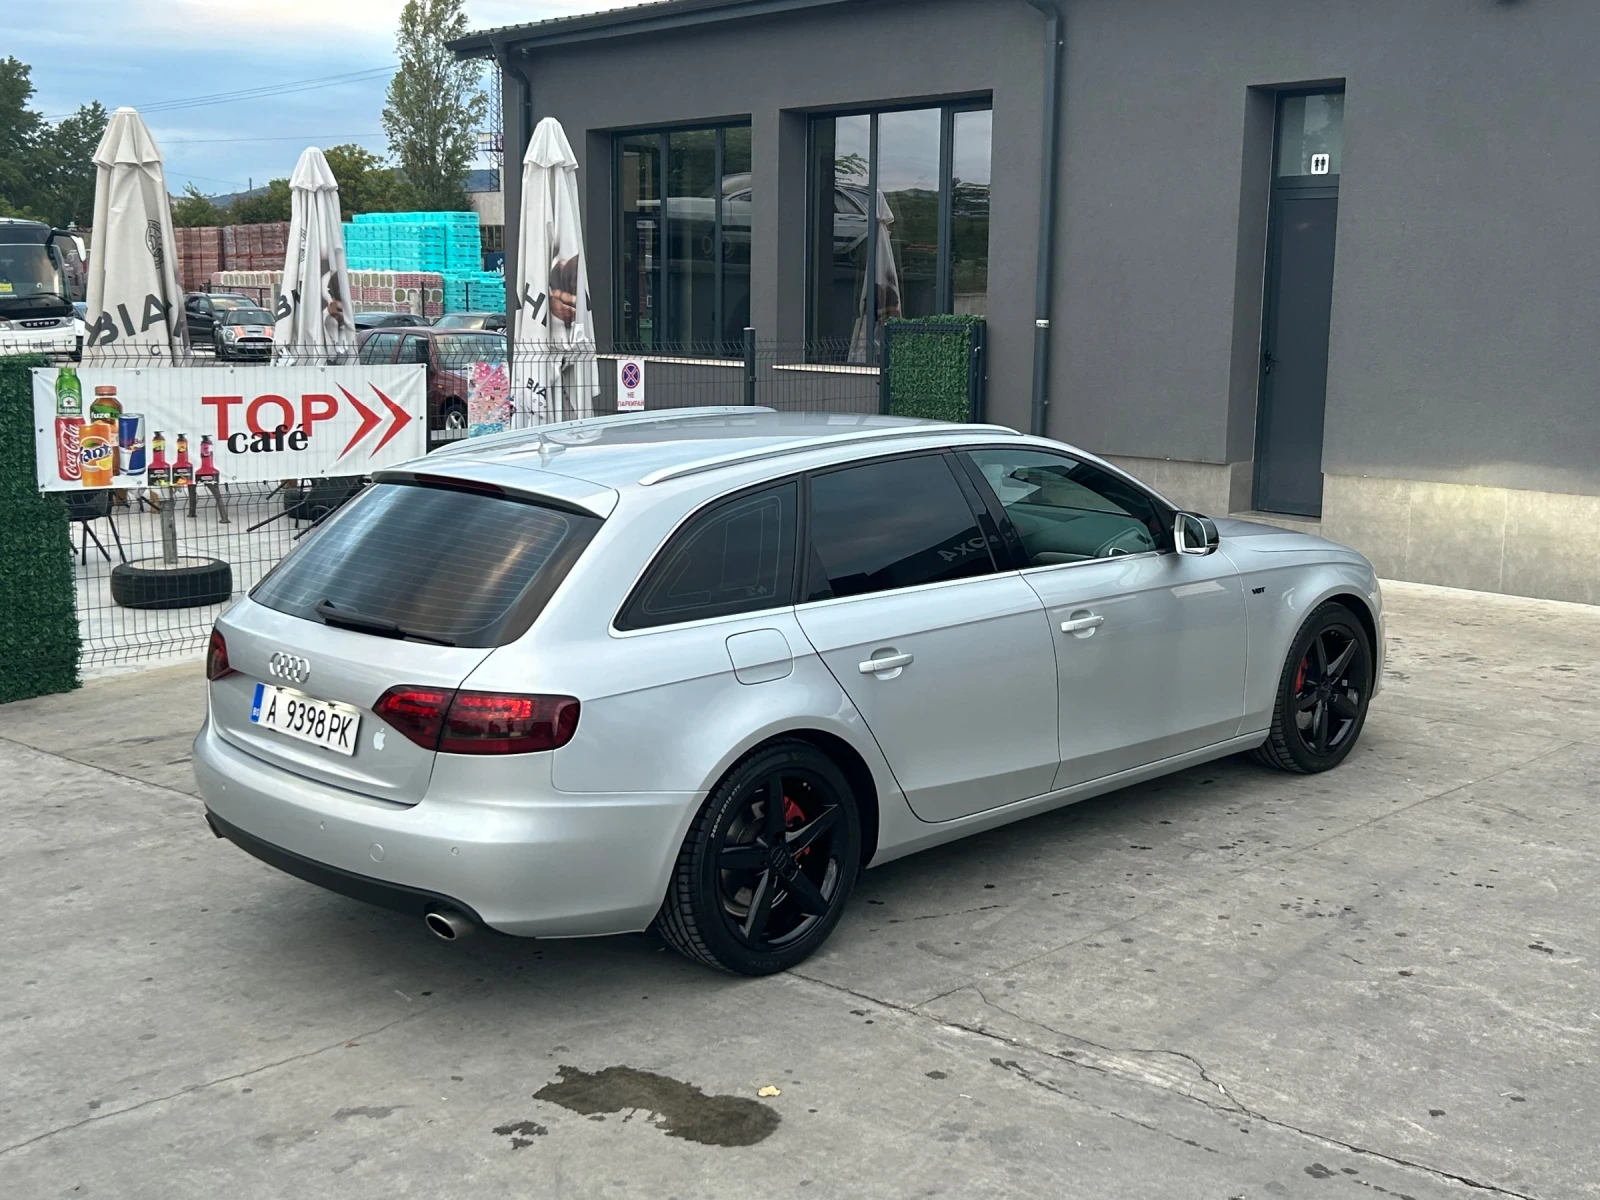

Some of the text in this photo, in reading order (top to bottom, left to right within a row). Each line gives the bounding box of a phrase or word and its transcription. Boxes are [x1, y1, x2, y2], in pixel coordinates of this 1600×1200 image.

[201, 394, 339, 440] TOP
[227, 424, 308, 454] café
[266, 695, 277, 724] A
